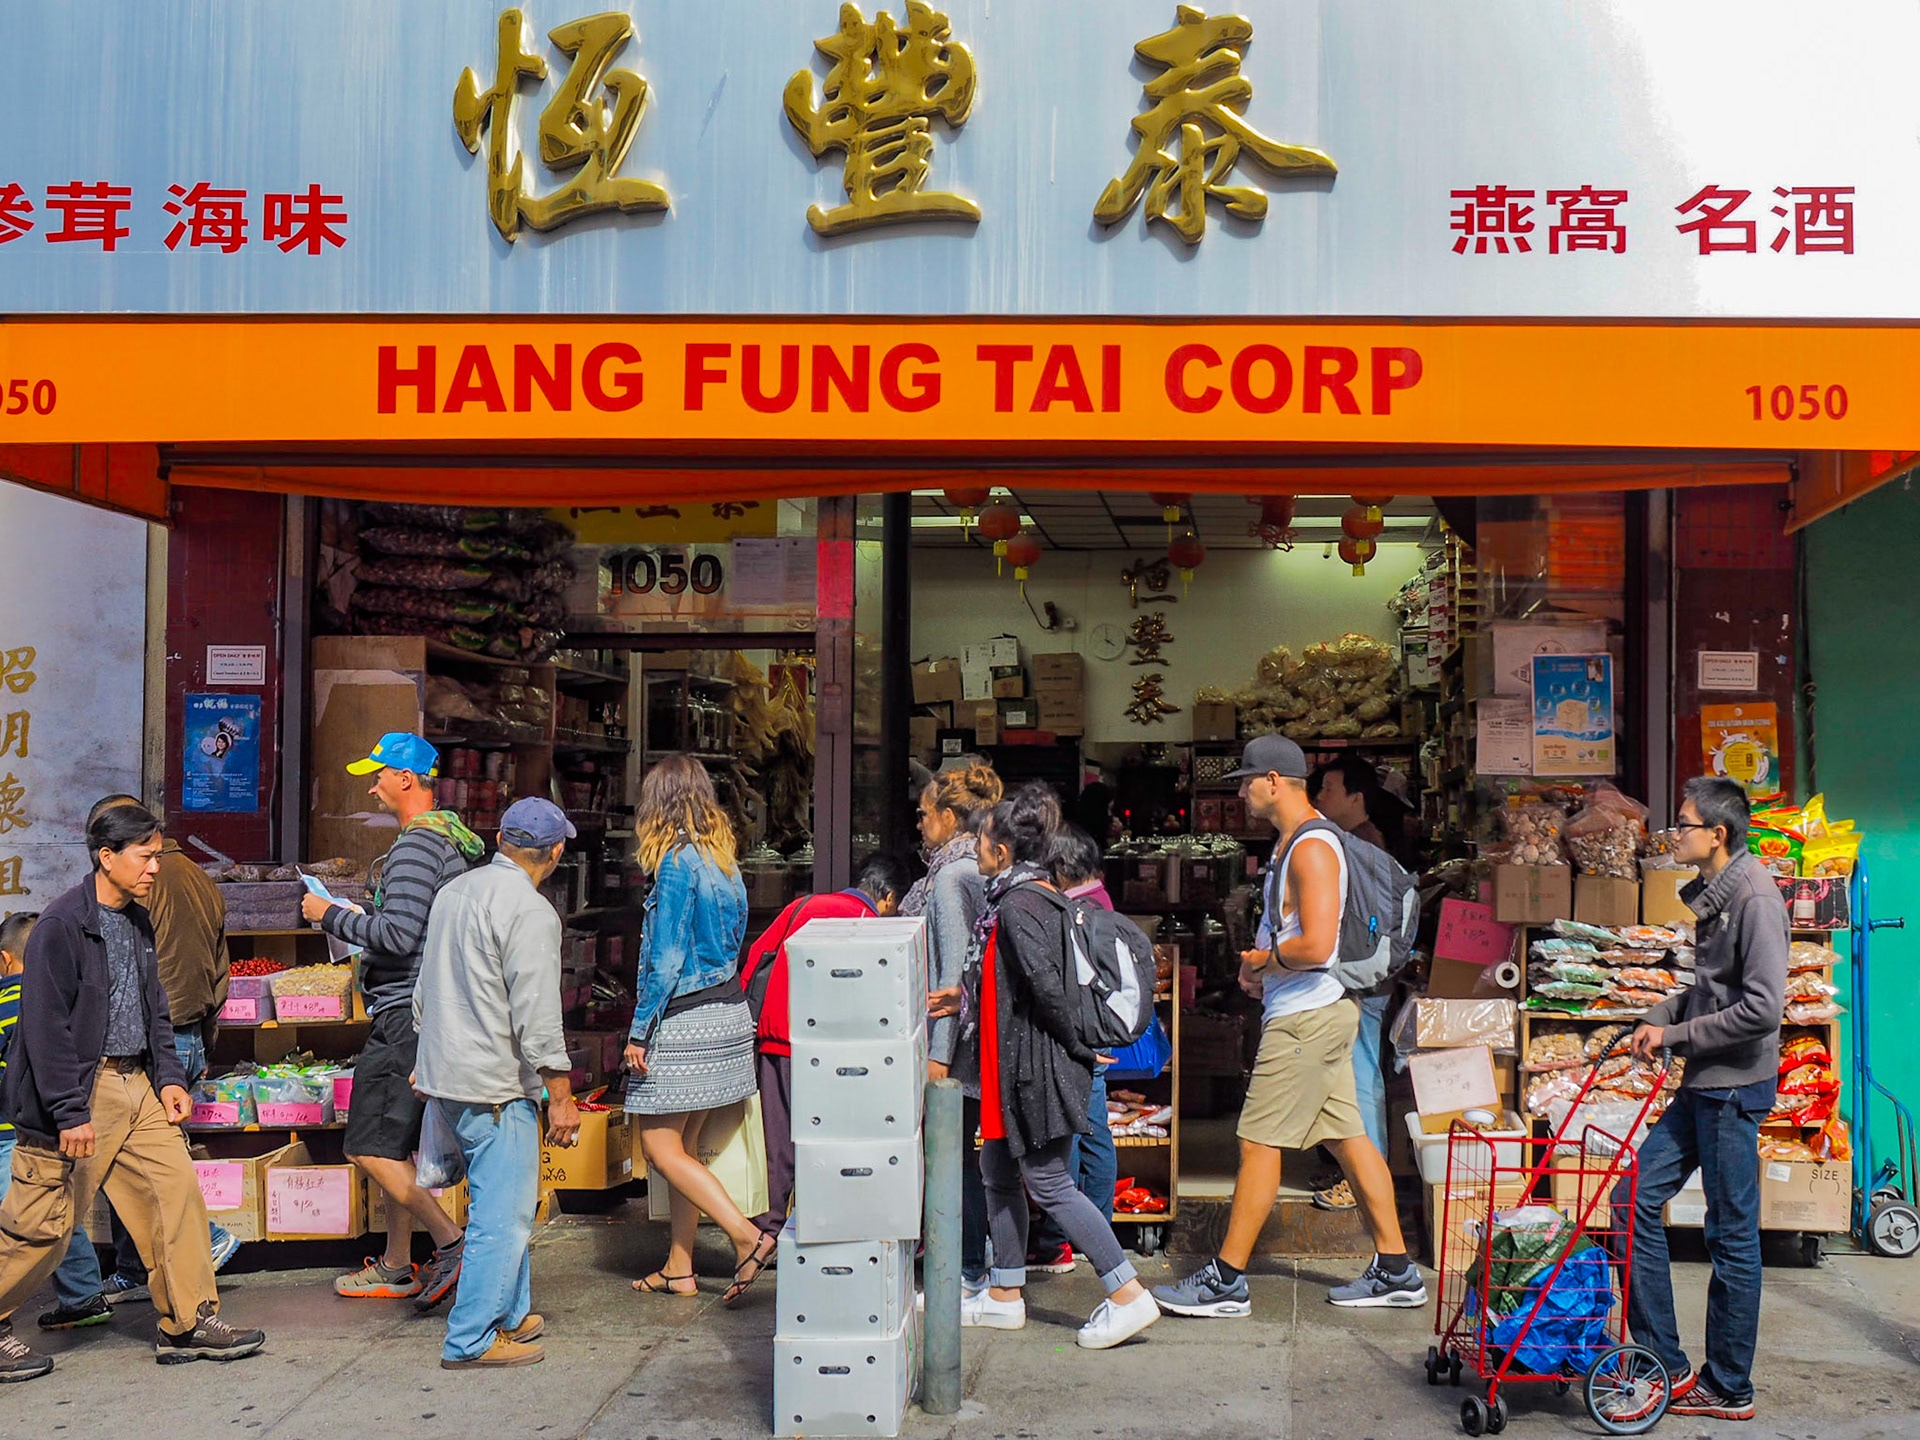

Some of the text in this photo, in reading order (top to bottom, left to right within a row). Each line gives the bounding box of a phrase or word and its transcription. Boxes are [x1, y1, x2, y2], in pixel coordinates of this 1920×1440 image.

[163, 182, 348, 255] 海味
[1450, 184, 1855, 255] 燕窩 名酒
[0, 378, 57, 416] 50
[377, 342, 1423, 416] HANG FUNG TAI CORP
[1744, 383, 1849, 422] 1050
[609, 554, 723, 595] 1050
[1811, 1168, 1839, 1180] SIZE
[1484, 1205, 1511, 1216] SZE
